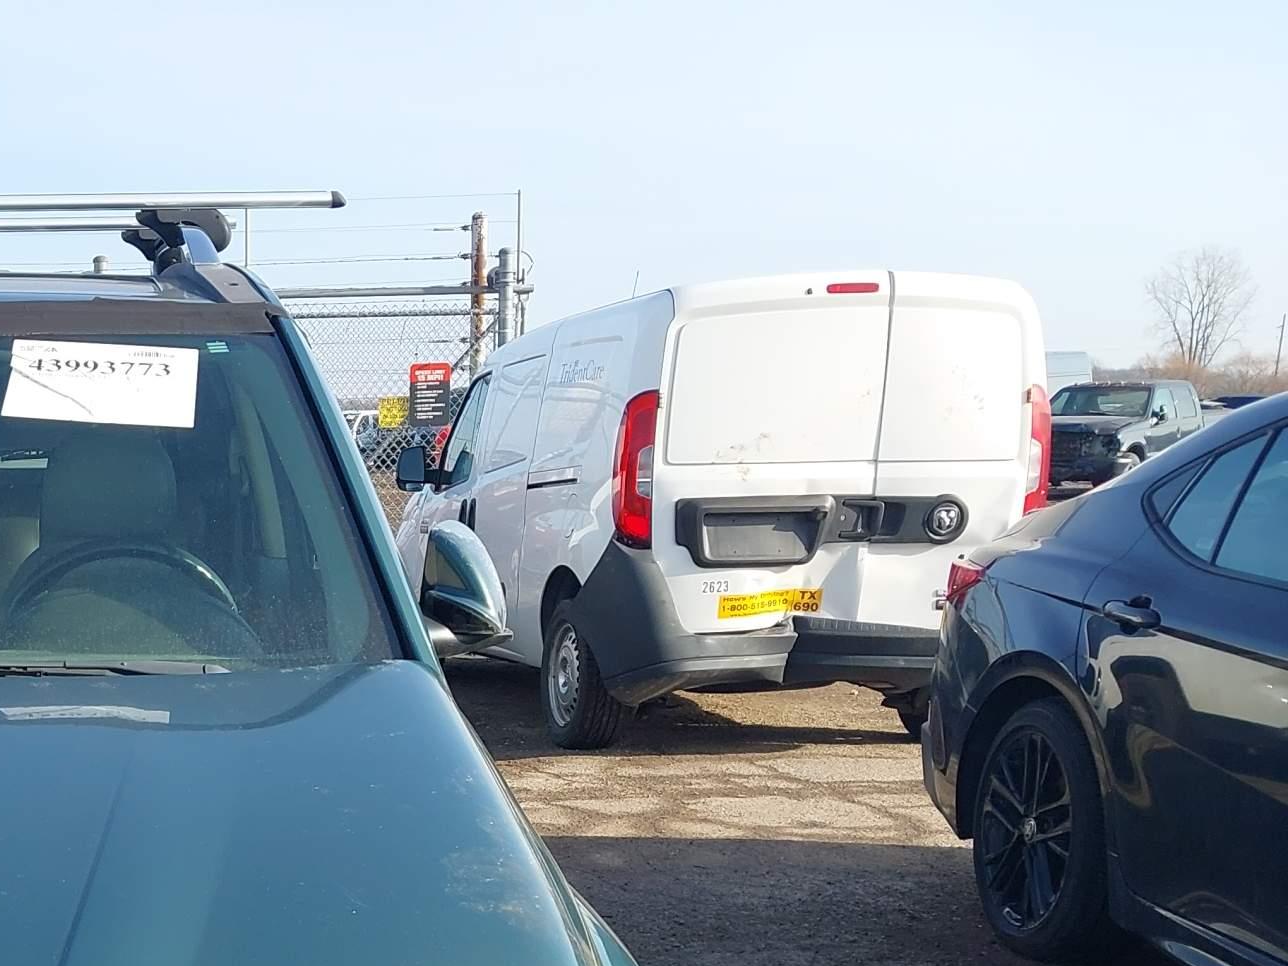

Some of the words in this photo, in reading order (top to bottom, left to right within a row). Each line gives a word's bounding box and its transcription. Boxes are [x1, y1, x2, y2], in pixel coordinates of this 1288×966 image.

[28, 357, 171, 377] 43993773
[702, 580, 729, 593] 2623
[799, 590, 817, 600] TX
[793, 602, 819, 612] 690
